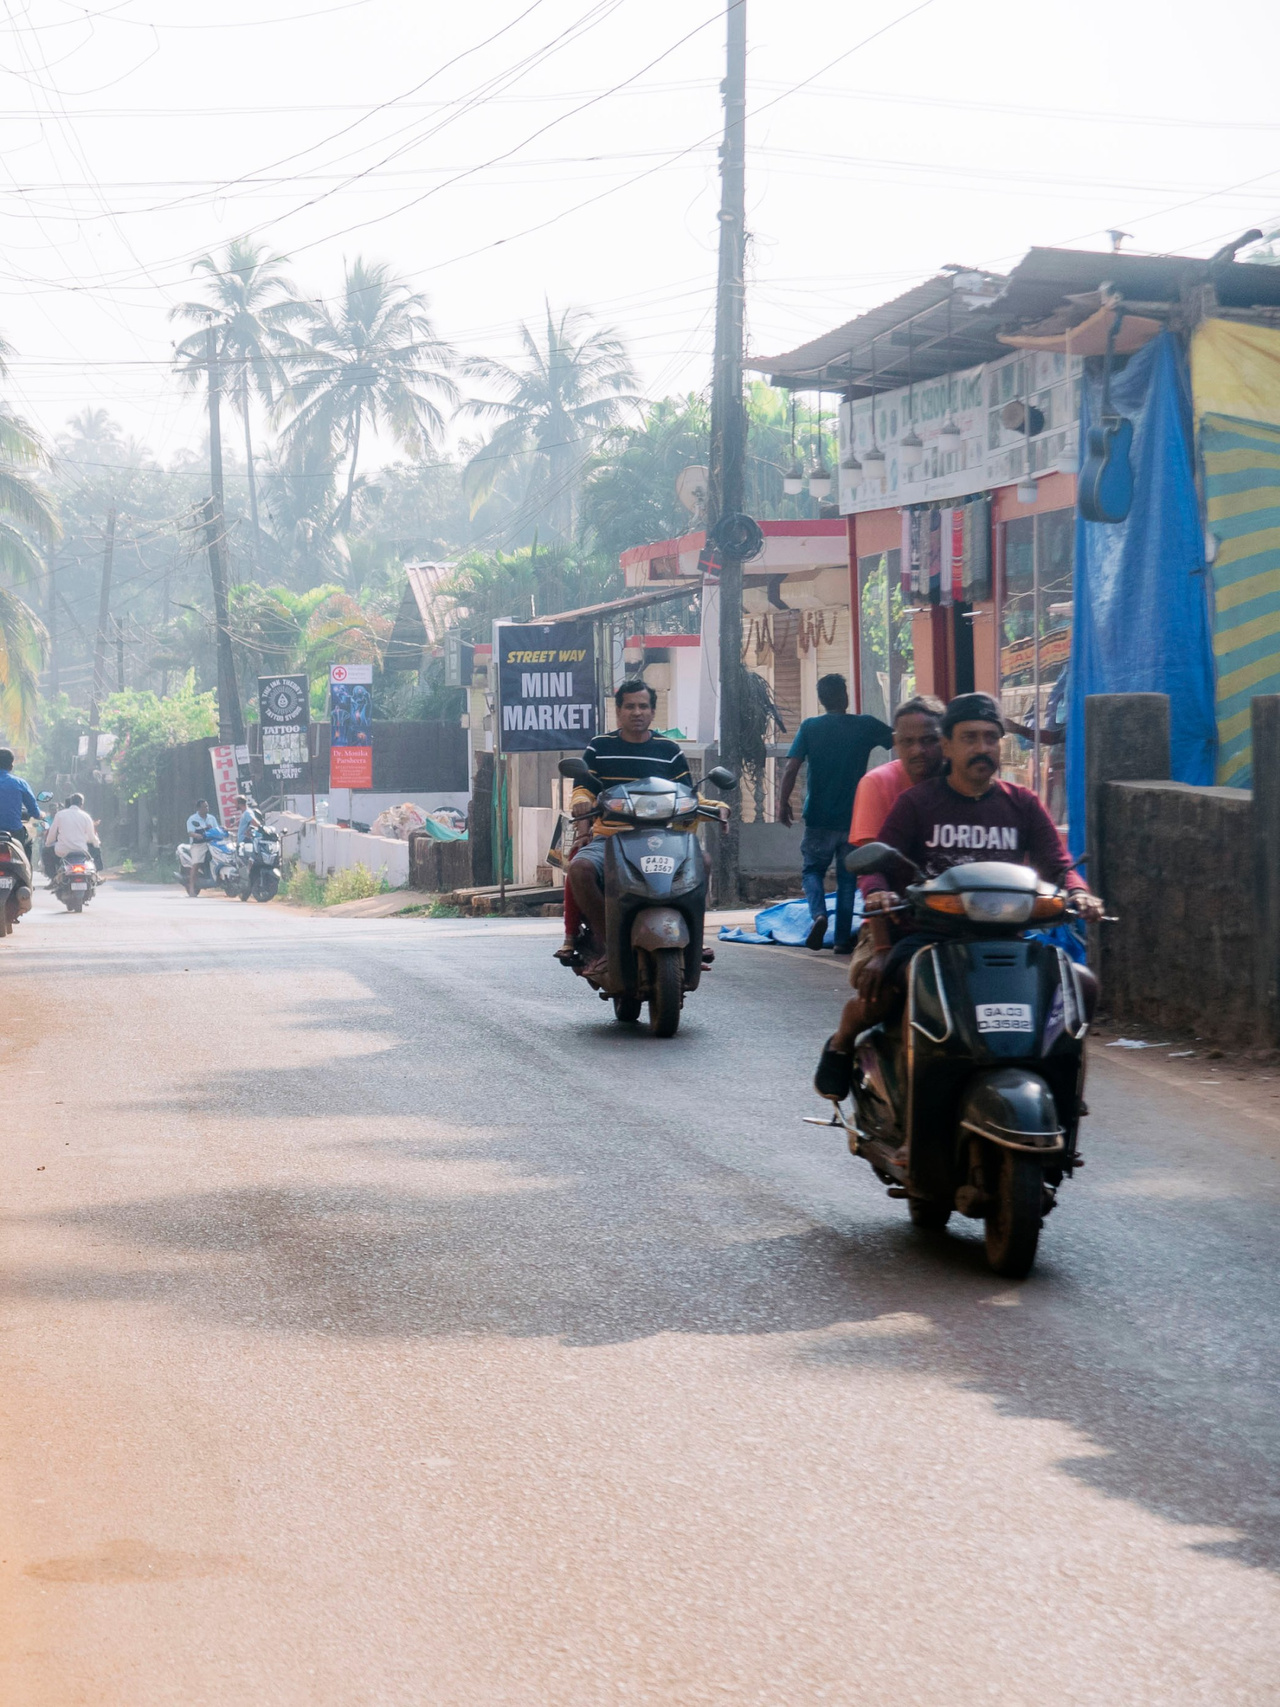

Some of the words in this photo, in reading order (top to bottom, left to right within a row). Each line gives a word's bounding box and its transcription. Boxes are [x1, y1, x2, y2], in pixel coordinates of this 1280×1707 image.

[507, 650, 557, 664] STREET
[521, 671, 573, 698] MINI
[503, 704, 592, 731] MARKET
[263, 725, 300, 735] TATTOO
[924, 824, 1018, 850] JORDAN
[983, 1007, 1023, 1017] GA.03
